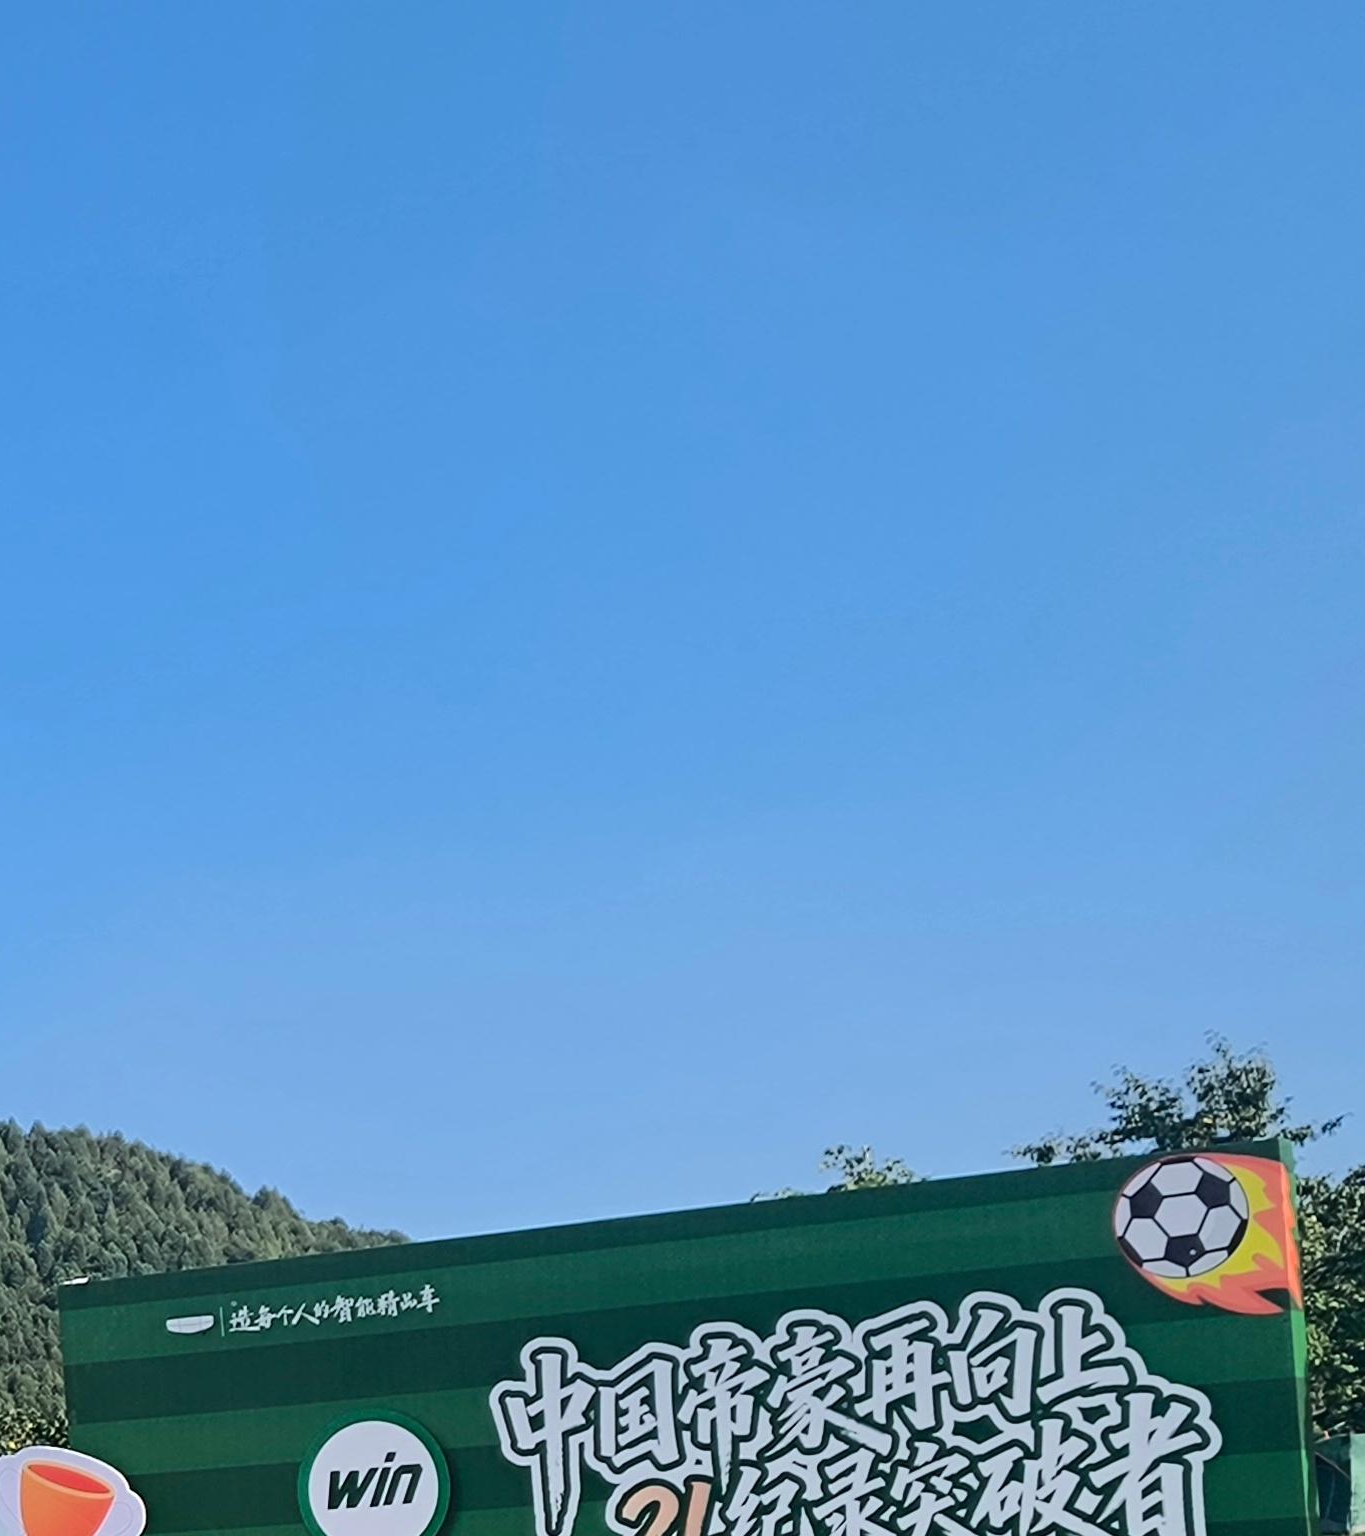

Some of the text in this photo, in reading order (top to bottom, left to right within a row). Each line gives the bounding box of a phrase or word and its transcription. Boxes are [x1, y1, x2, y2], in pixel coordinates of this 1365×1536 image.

[327, 1451, 423, 1510] win
[505, 1302, 1131, 1534] 中国帝豪再向上
